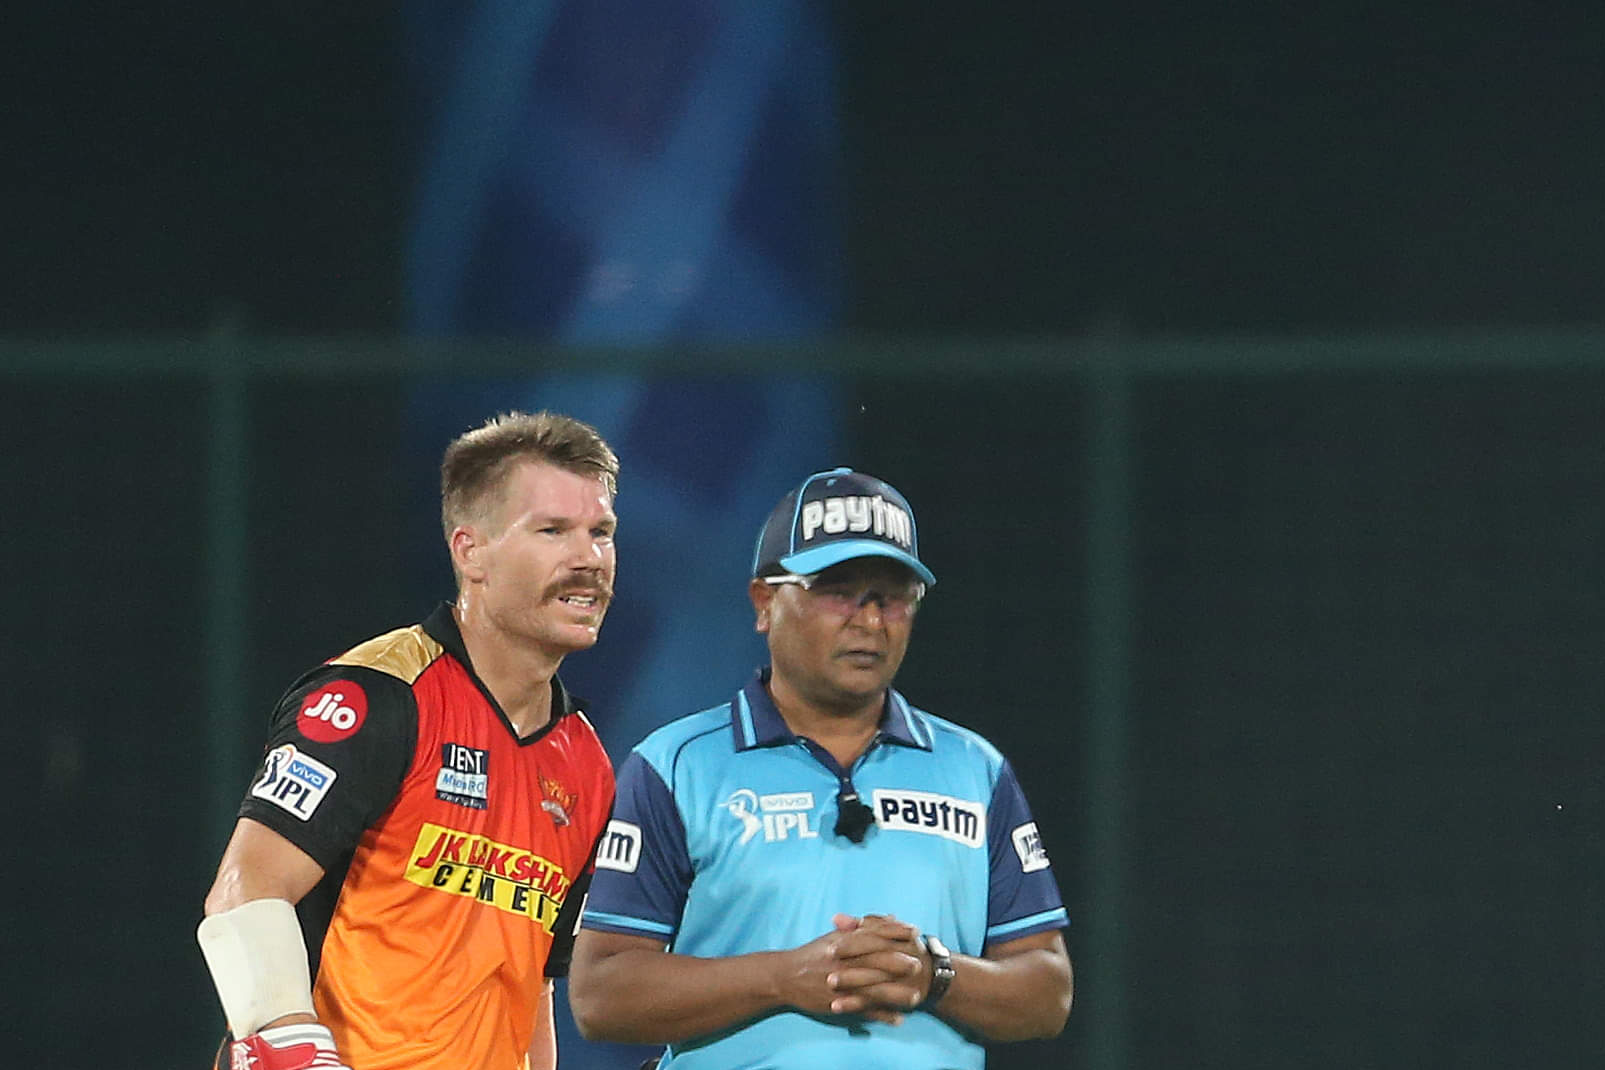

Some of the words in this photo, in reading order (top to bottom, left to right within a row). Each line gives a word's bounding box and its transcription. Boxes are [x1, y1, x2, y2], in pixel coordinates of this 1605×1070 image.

[803, 495, 911, 548] paytm
[304, 692, 357, 731] Jio
[292, 763, 323, 786] vivo
[271, 776, 312, 815] IPL
[763, 811, 819, 842] IPL
[880, 798, 978, 841] paytm
[415, 832, 465, 869] JK
